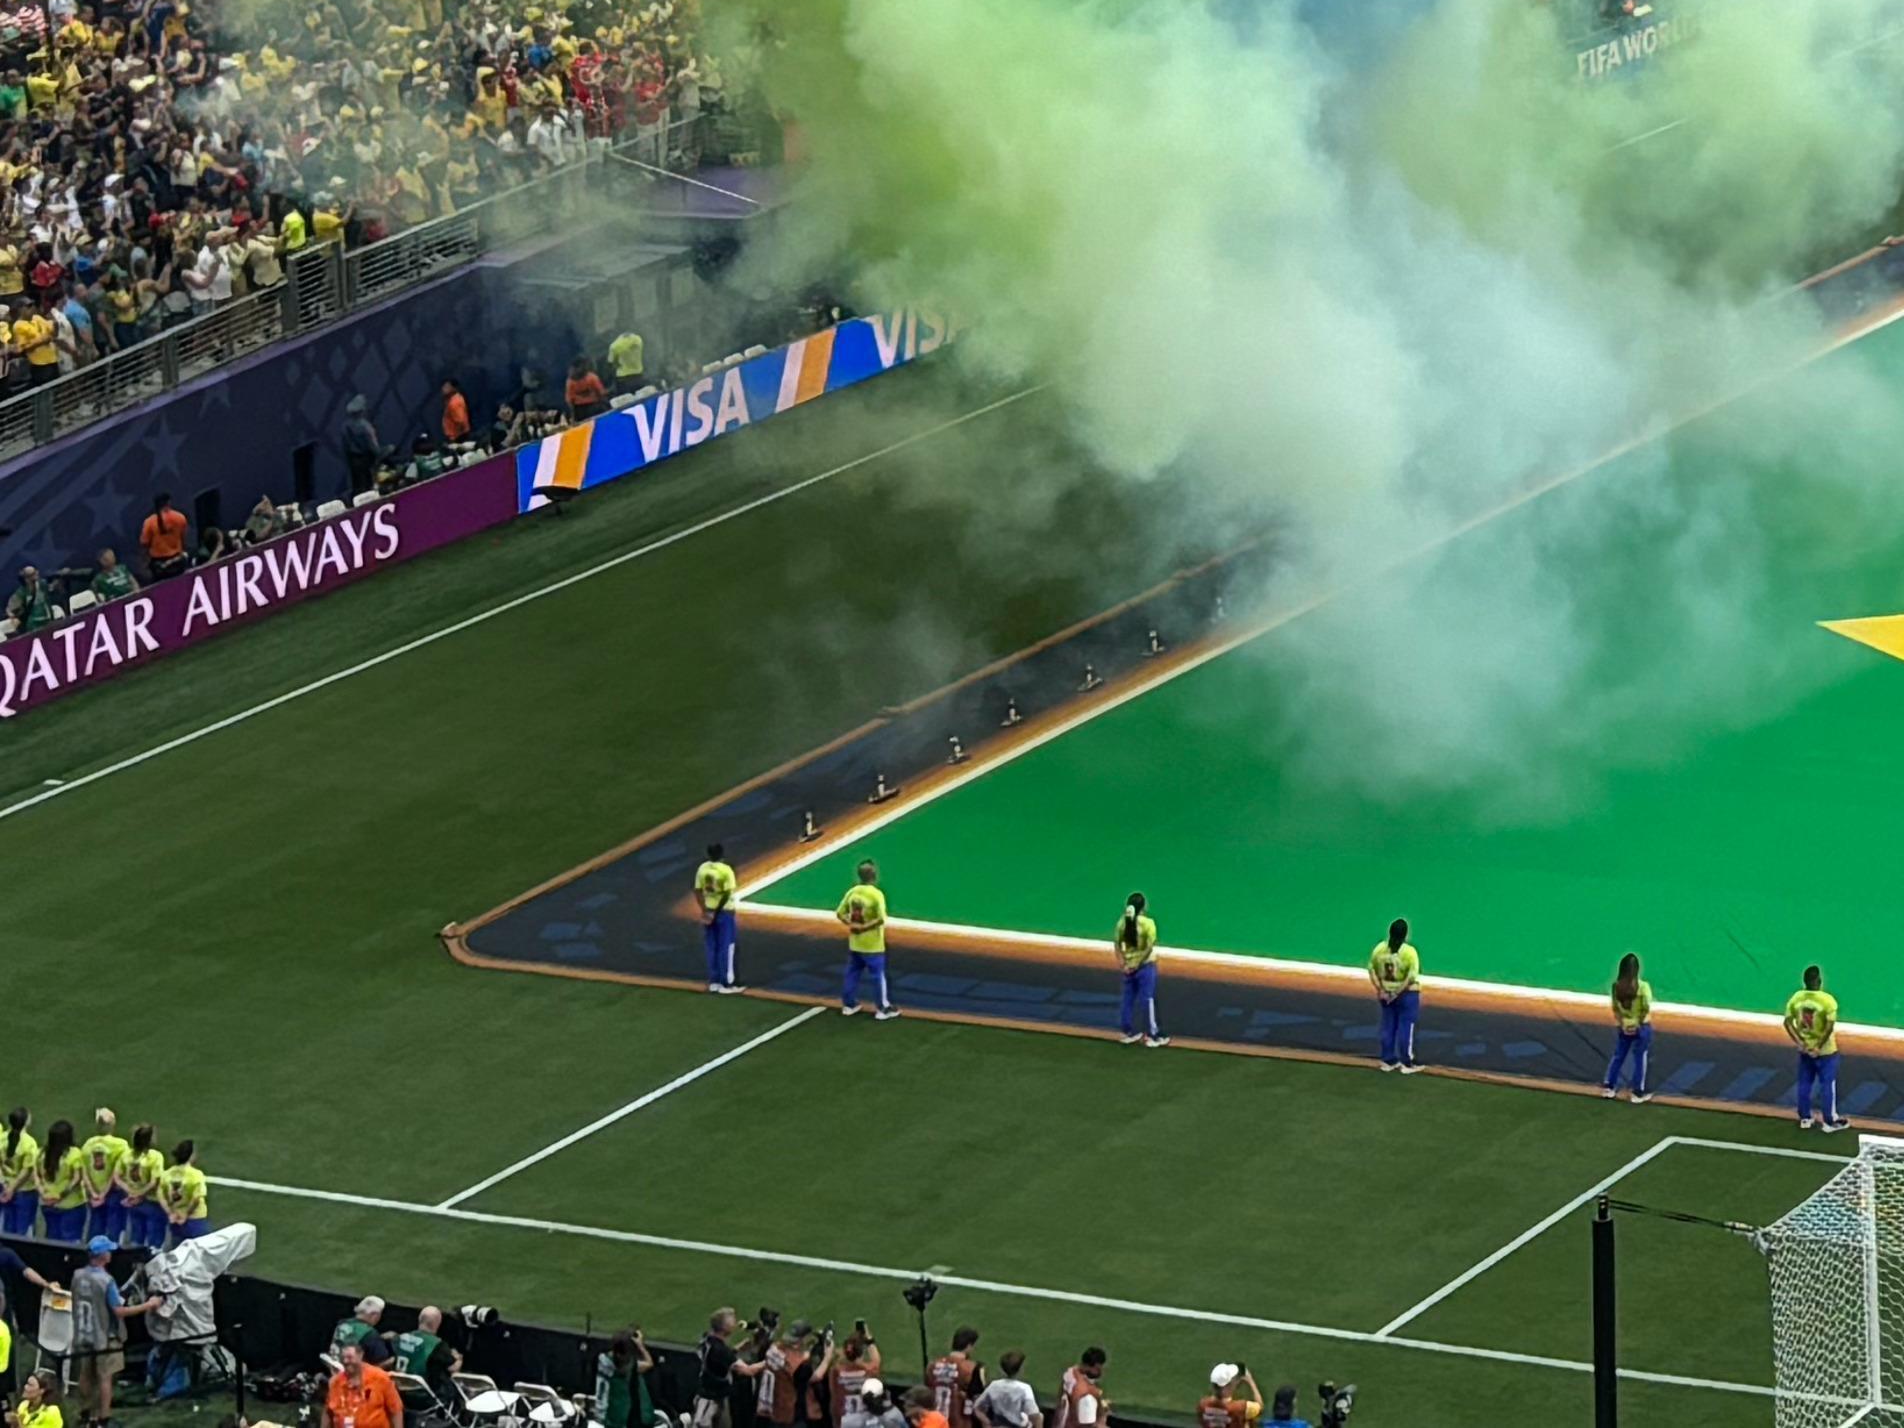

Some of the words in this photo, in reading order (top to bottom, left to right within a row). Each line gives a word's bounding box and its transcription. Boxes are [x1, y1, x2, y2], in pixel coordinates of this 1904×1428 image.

[862, 304, 957, 369] VIS
[620, 366, 751, 464] VISA
[182, 503, 400, 637] AIRWAYS
